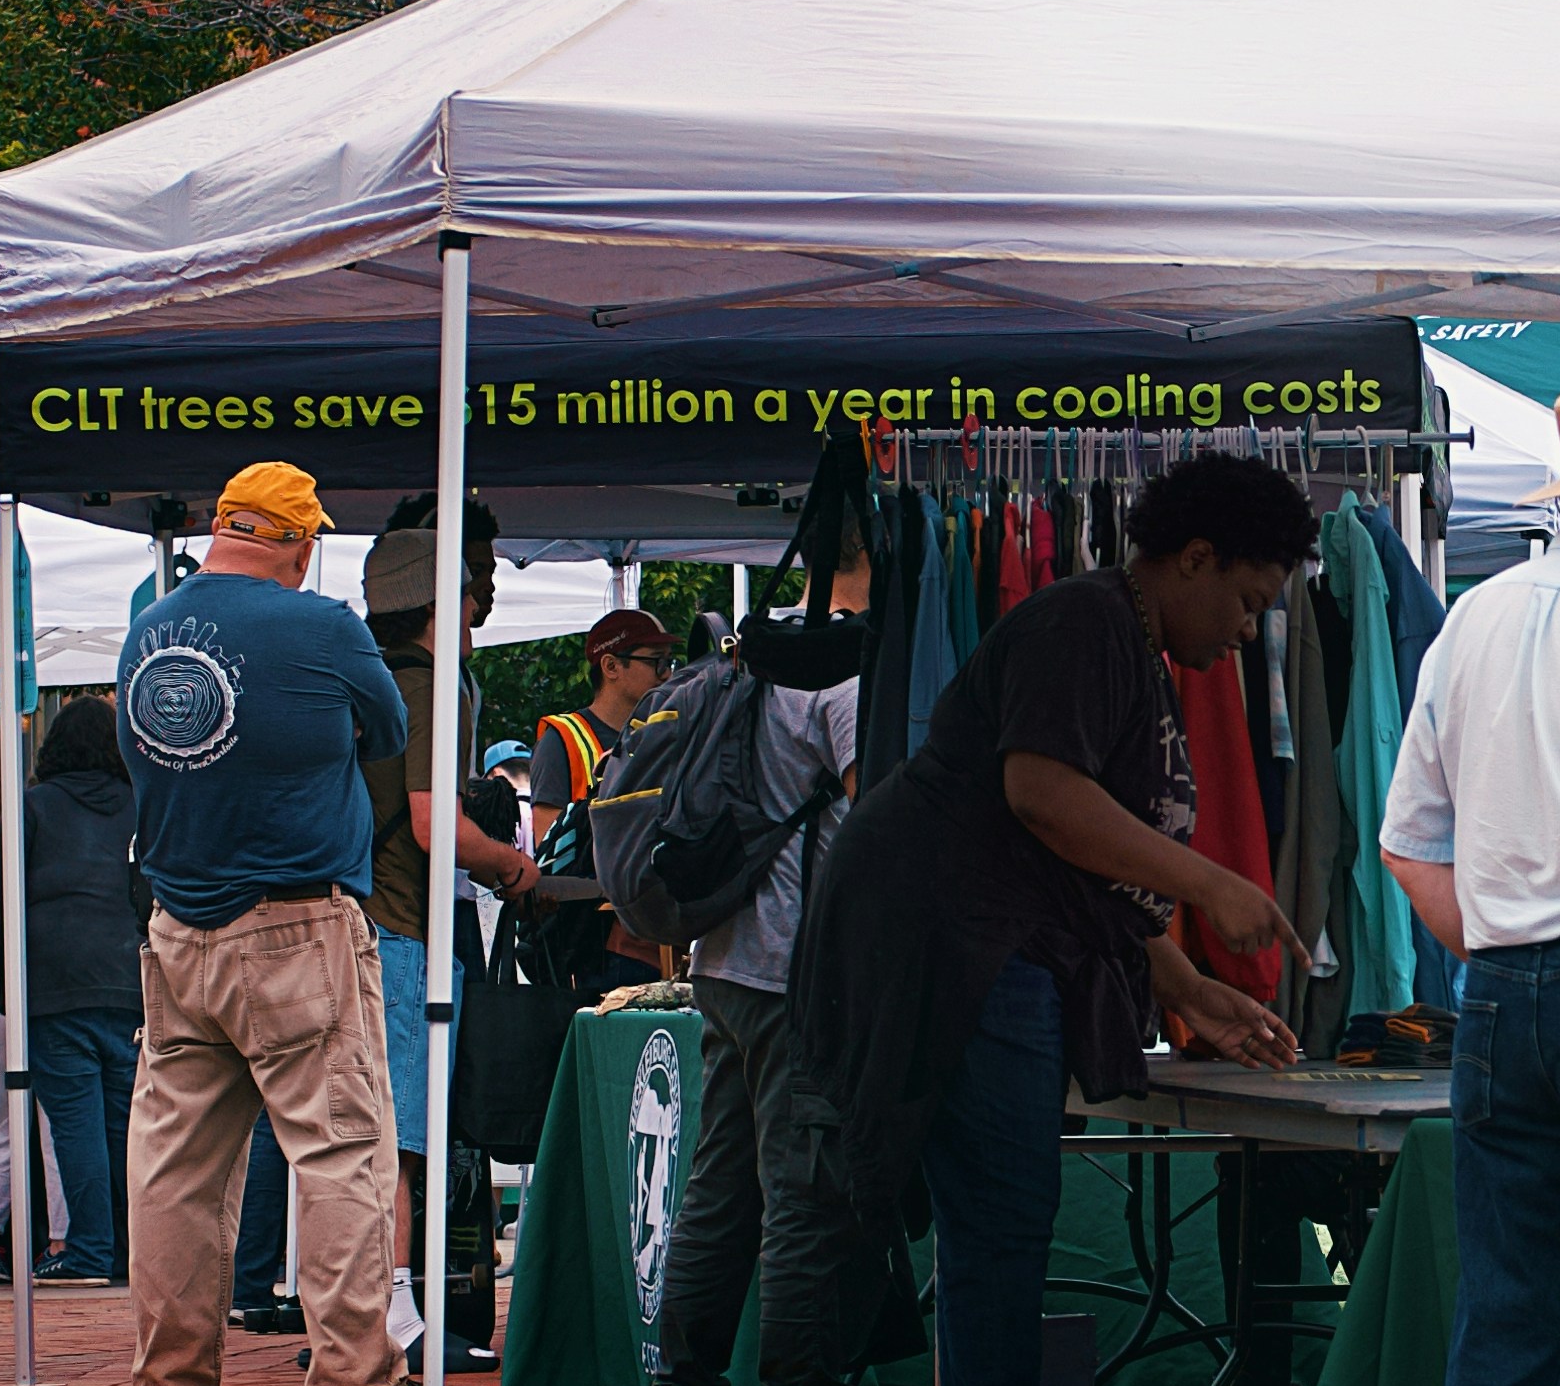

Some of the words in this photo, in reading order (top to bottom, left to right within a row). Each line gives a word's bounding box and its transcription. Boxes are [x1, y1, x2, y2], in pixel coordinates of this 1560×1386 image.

[1430, 321, 1532, 341] SAFETY
[31, 386, 125, 432] CLT
[139, 386, 275, 430] trees
[293, 393, 424, 429] save
[557, 378, 735, 425] million
[753, 387, 788, 423] a
[806, 386, 934, 433] year
[951, 376, 996, 421] in
[1016, 373, 1223, 427] cooling
[1242, 368, 1382, 414] costs
